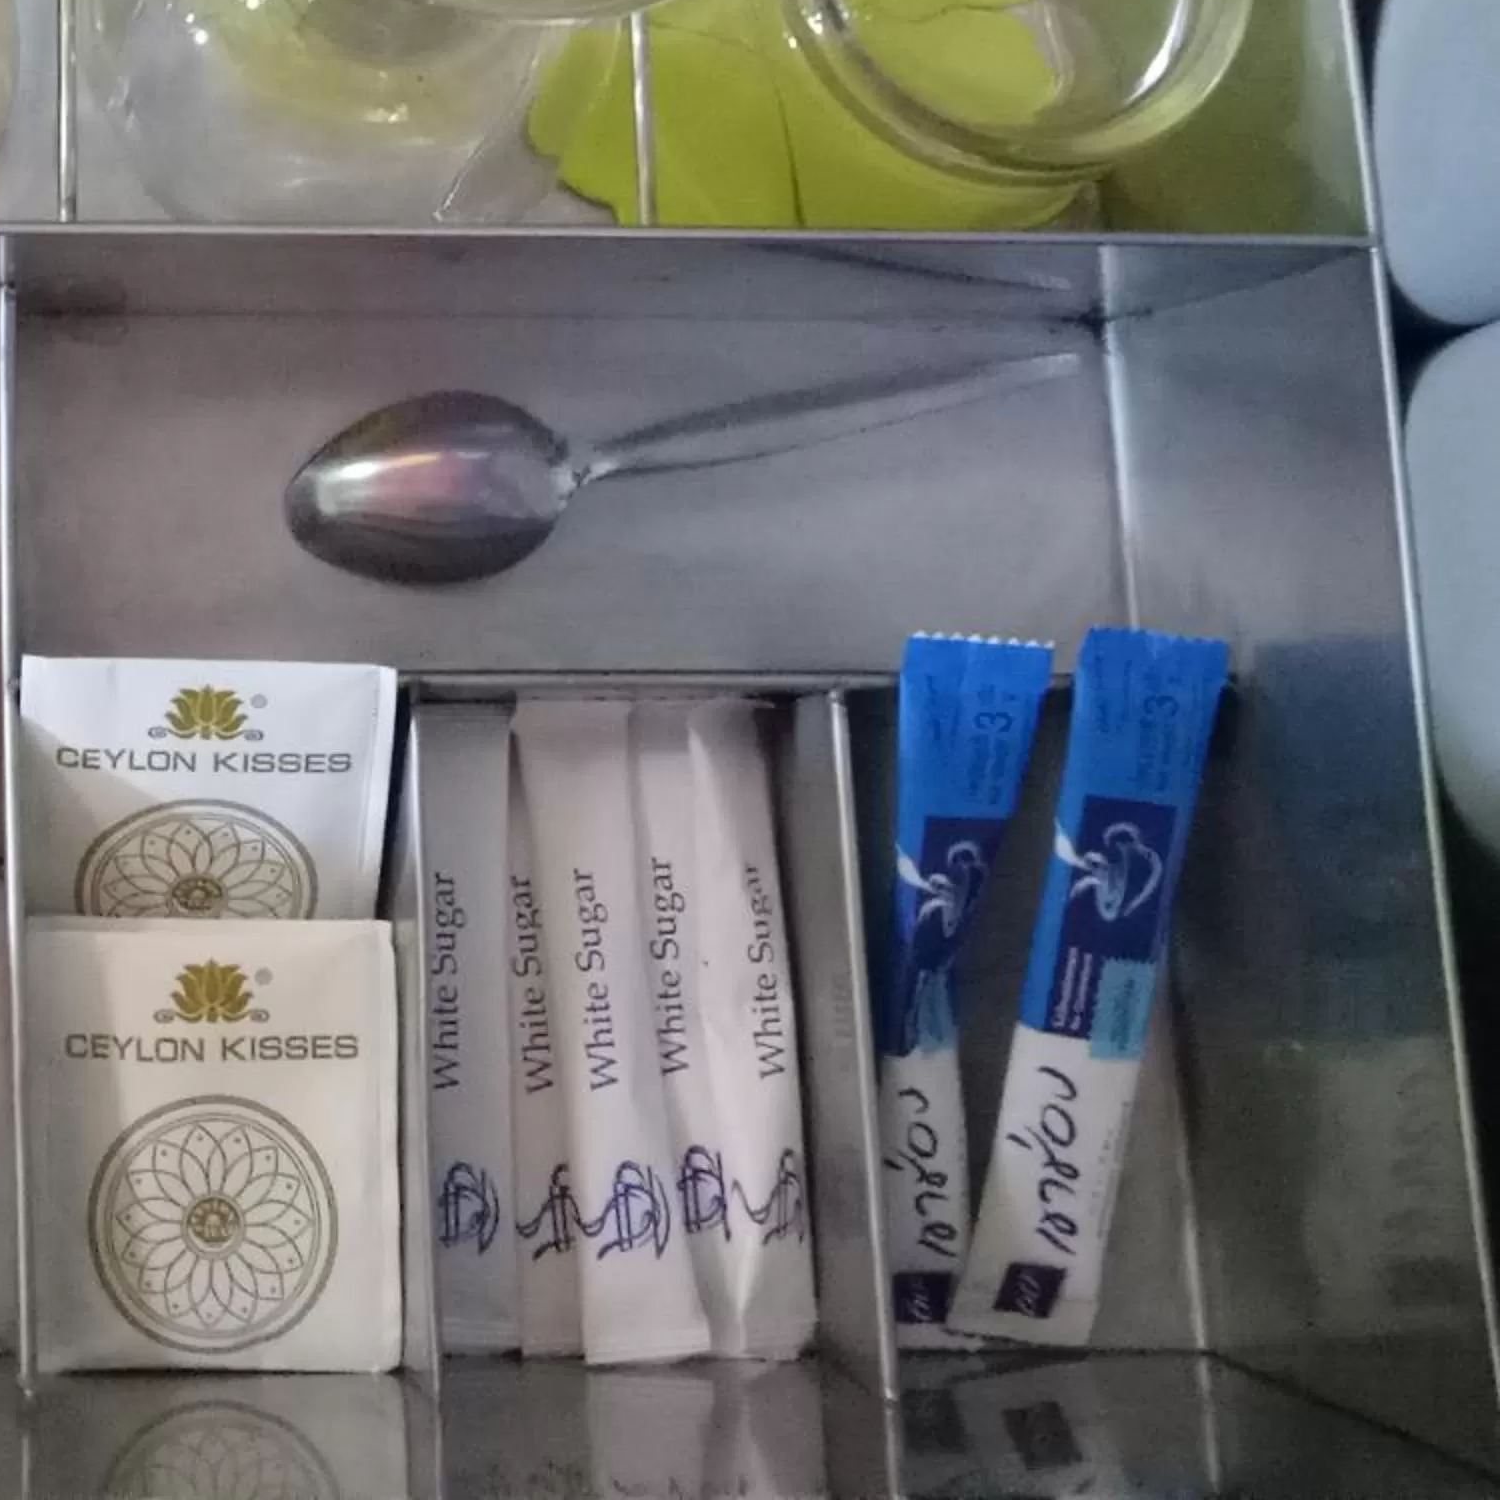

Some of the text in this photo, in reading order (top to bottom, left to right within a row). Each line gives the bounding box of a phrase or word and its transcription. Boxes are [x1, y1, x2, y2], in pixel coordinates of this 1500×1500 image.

[56, 746, 353, 774] CEYLON KISSES
[65, 1033, 359, 1062] CEYLON KISSES
[431, 871, 465, 1091] White Sugar
[510, 874, 554, 1095] White Sugar
[573, 868, 619, 1092] White Sugar
[650, 856, 690, 1078] White Sugar
[752, 973, 786, 1080] White
